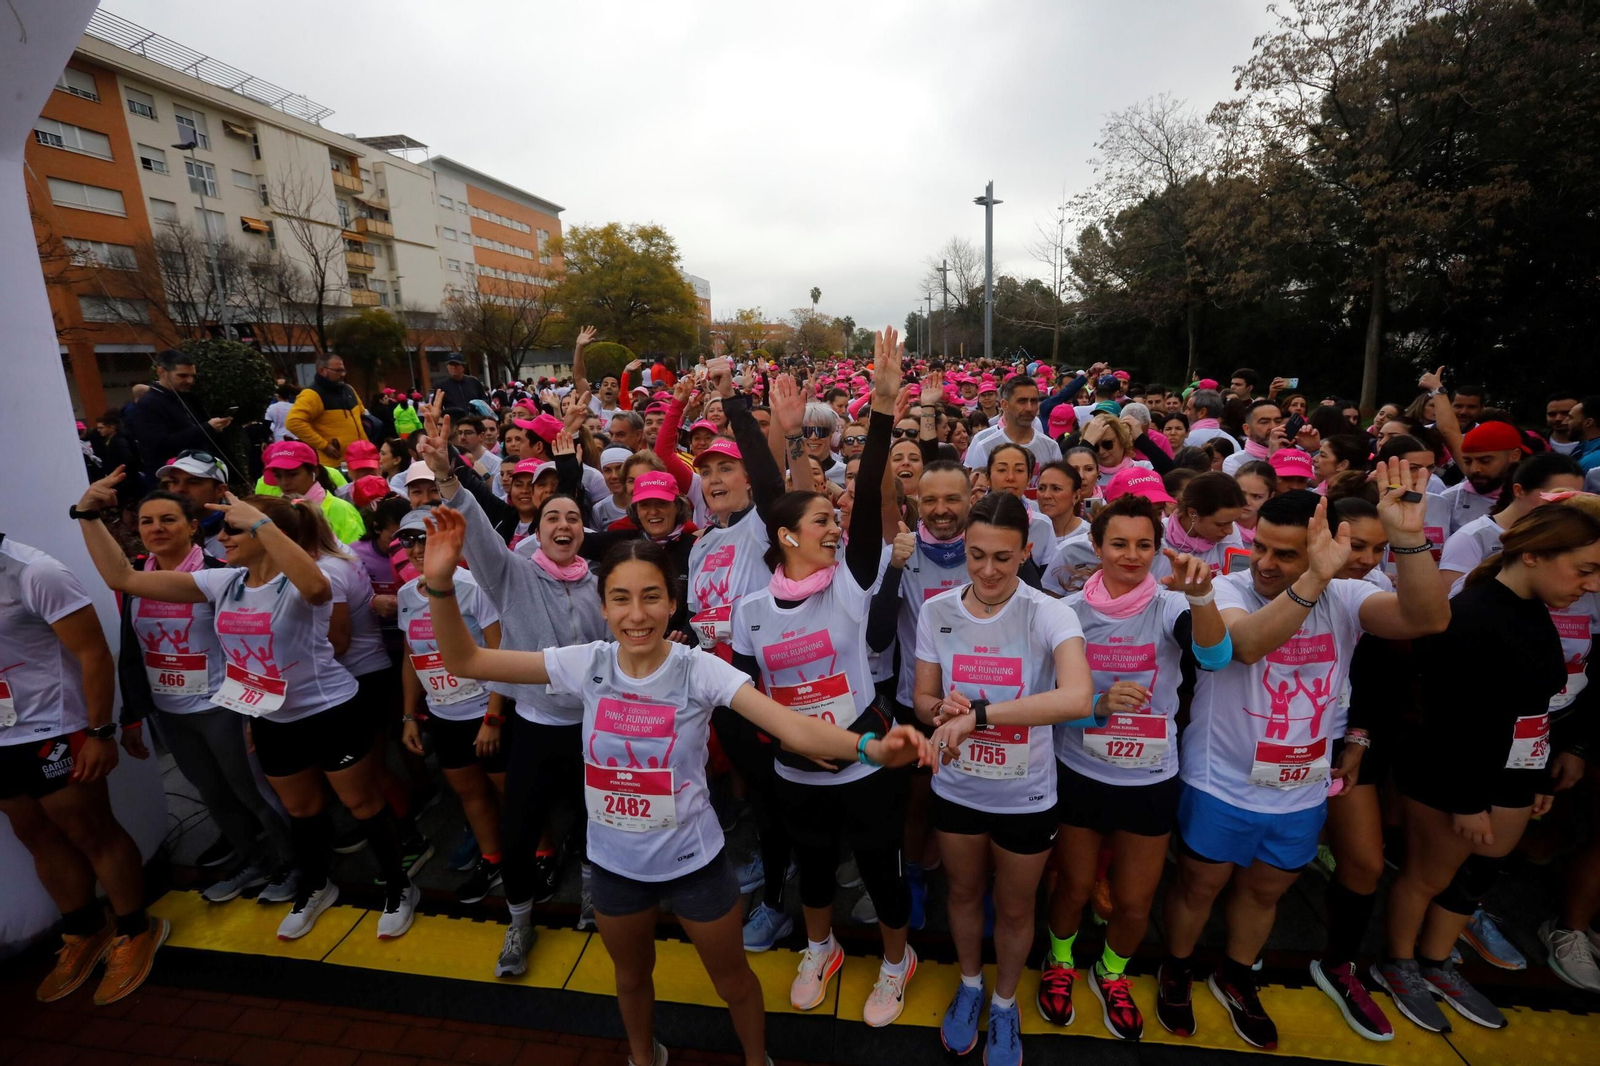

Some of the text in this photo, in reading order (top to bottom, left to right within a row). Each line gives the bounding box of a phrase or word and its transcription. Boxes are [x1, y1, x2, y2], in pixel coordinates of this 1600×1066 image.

[771, 641, 824, 662] PINK RUNNING
[1292, 644, 1327, 656] RUNNING
[1093, 653, 1148, 663] PINK RUNNING
[959, 664, 1014, 676] PINK RUNNING
[968, 673, 993, 681] CADENA
[158, 673, 186, 687] 466
[429, 673, 458, 690] 976
[239, 687, 265, 706] 767
[797, 685, 813, 695] 100
[604, 709, 665, 725] PINK RUNNING
[1117, 717, 1133, 725] 100
[613, 722, 653, 733] CADENA 100
[968, 743, 1006, 766] 1755
[1105, 741, 1145, 758] 1227
[42, 756, 74, 774] GARITO
[45, 763, 76, 780] RUNNING
[616, 772, 633, 780] 100
[1279, 767, 1310, 782] 547
[603, 795, 651, 818] 2482
